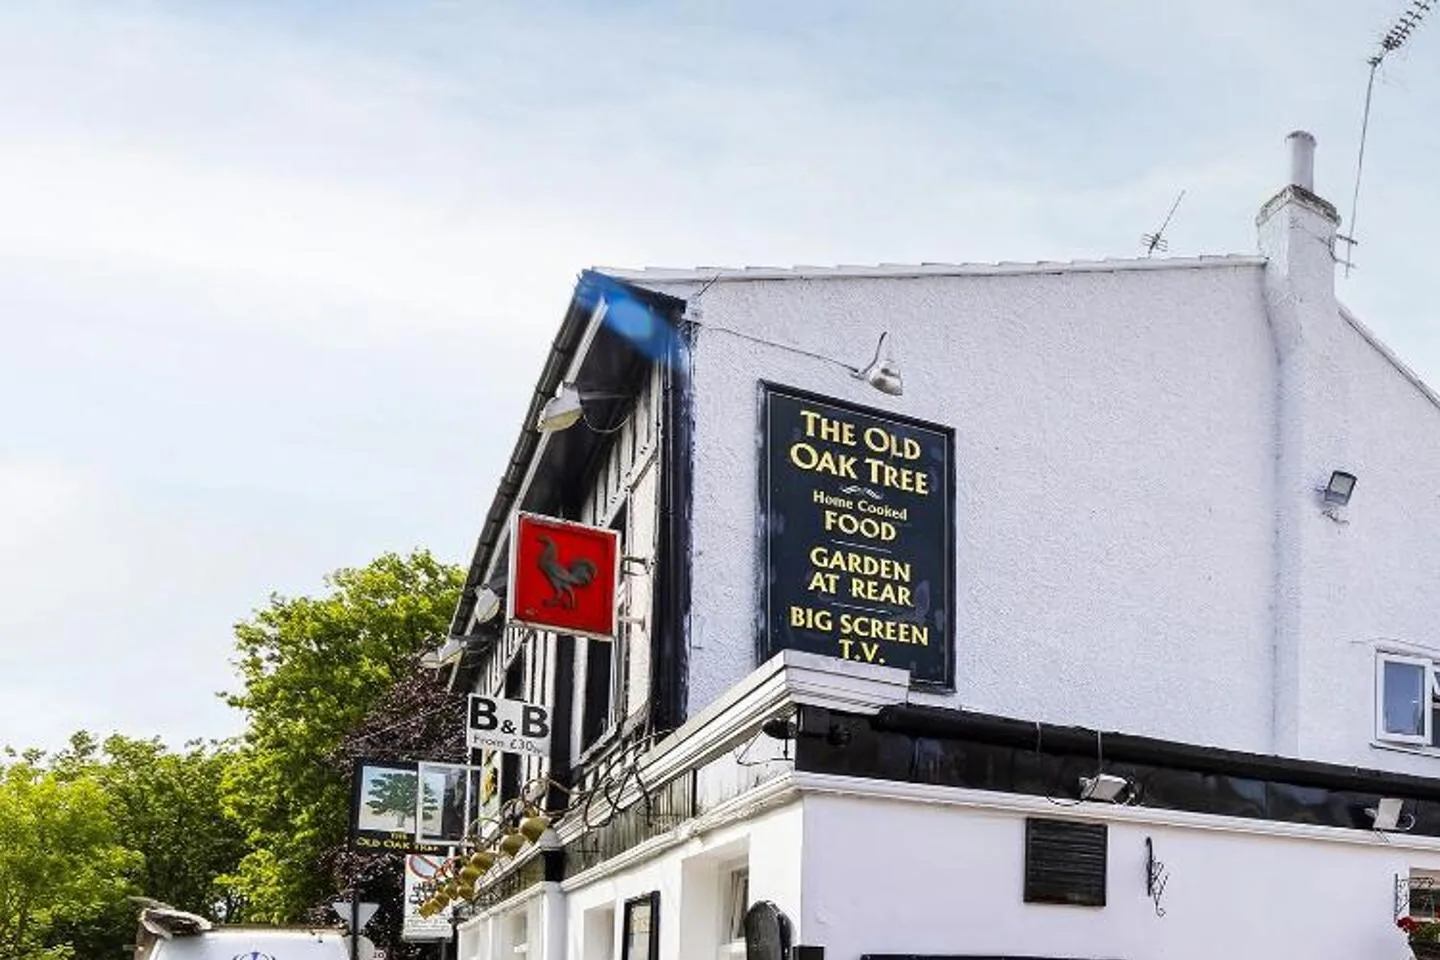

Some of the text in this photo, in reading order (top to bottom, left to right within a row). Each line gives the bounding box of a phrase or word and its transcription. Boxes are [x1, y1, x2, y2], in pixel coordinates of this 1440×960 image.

[800, 410, 921, 461] THE OLD
[790, 442, 929, 495] OAK TREE
[813, 489, 908, 522] Home Cooked
[824, 510, 897, 542] FOOD
[810, 546, 912, 583] GARDEN
[808, 573, 914, 608] AT REAR
[790, 606, 929, 647] BIG SCREEN
[838, 639, 886, 664] T.V.
[356, 837, 381, 848] OLD
[384, 840, 410, 850] OAK
